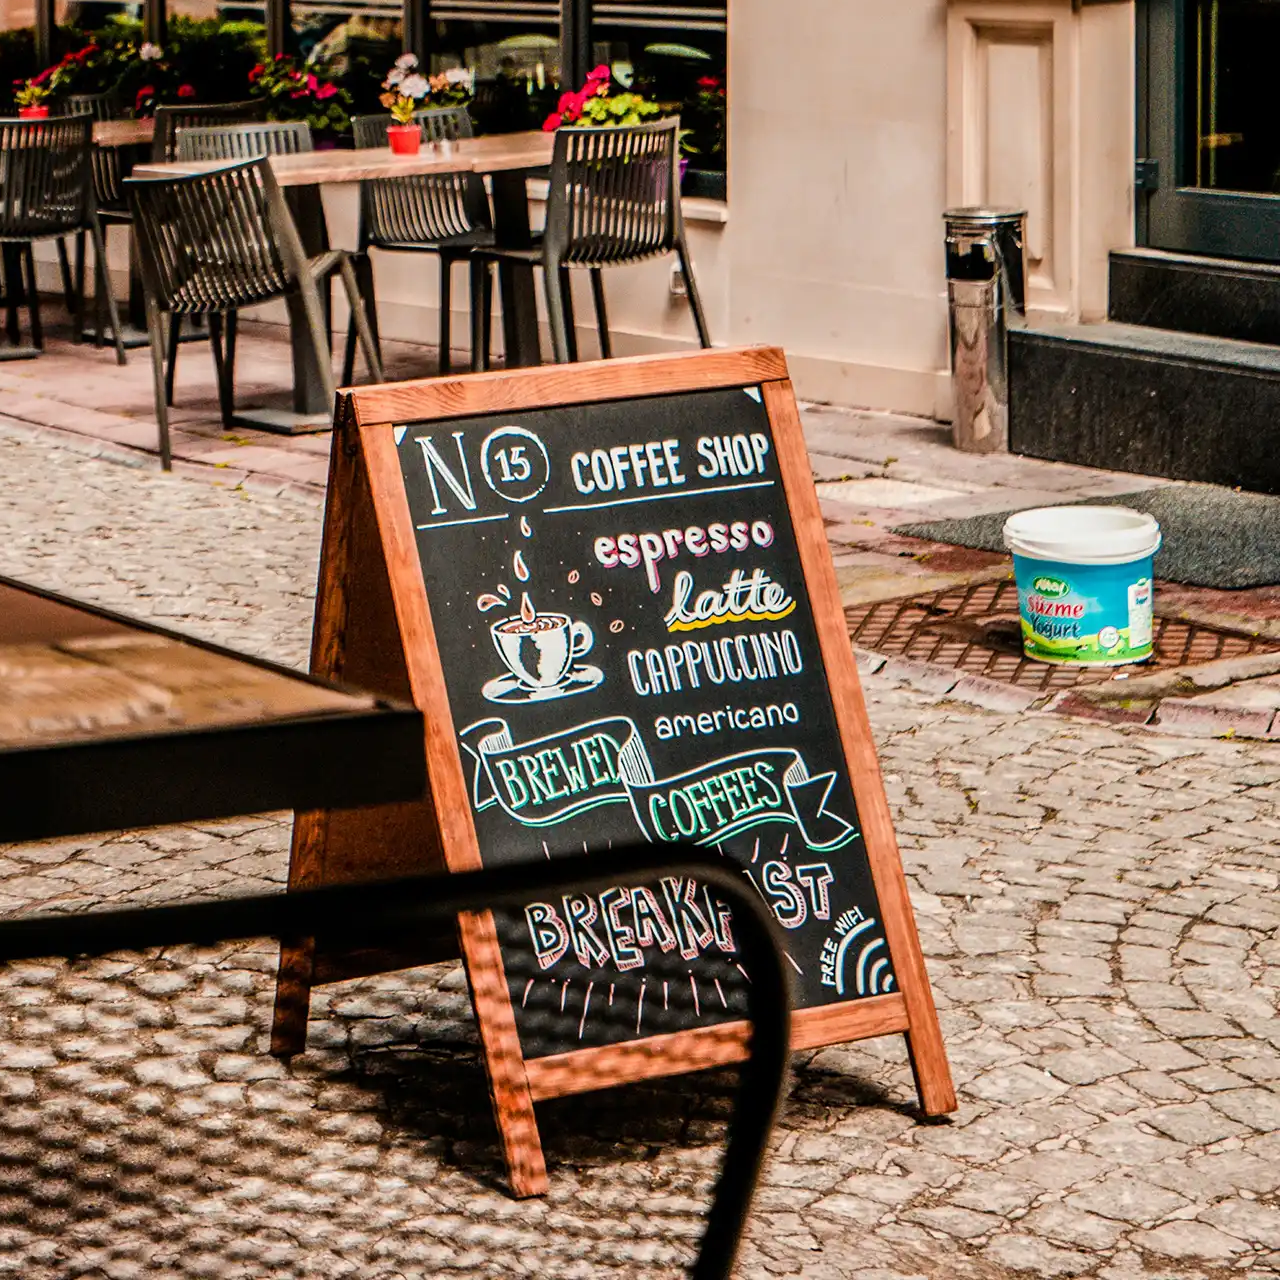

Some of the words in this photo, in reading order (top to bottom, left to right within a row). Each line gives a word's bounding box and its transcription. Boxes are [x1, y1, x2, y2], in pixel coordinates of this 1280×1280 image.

[493, 446, 532, 482] 15
[570, 439, 686, 495] COFFEE
[696, 433, 770, 477] SHOP
[594, 520, 774, 594] espresso
[664, 568, 796, 629] latte
[1026, 595, 1084, 618] Süzme
[1030, 615, 1081, 640] Yoğurt
[626, 630, 804, 697] CAPPUCCINO
[655, 702, 800, 741] americano
[496, 733, 624, 810] BREWED
[648, 761, 783, 842] COFFEES
[524, 861, 835, 972] BREAKFST
[820, 937, 839, 987] FREE
[833, 905, 866, 937] WIFI
